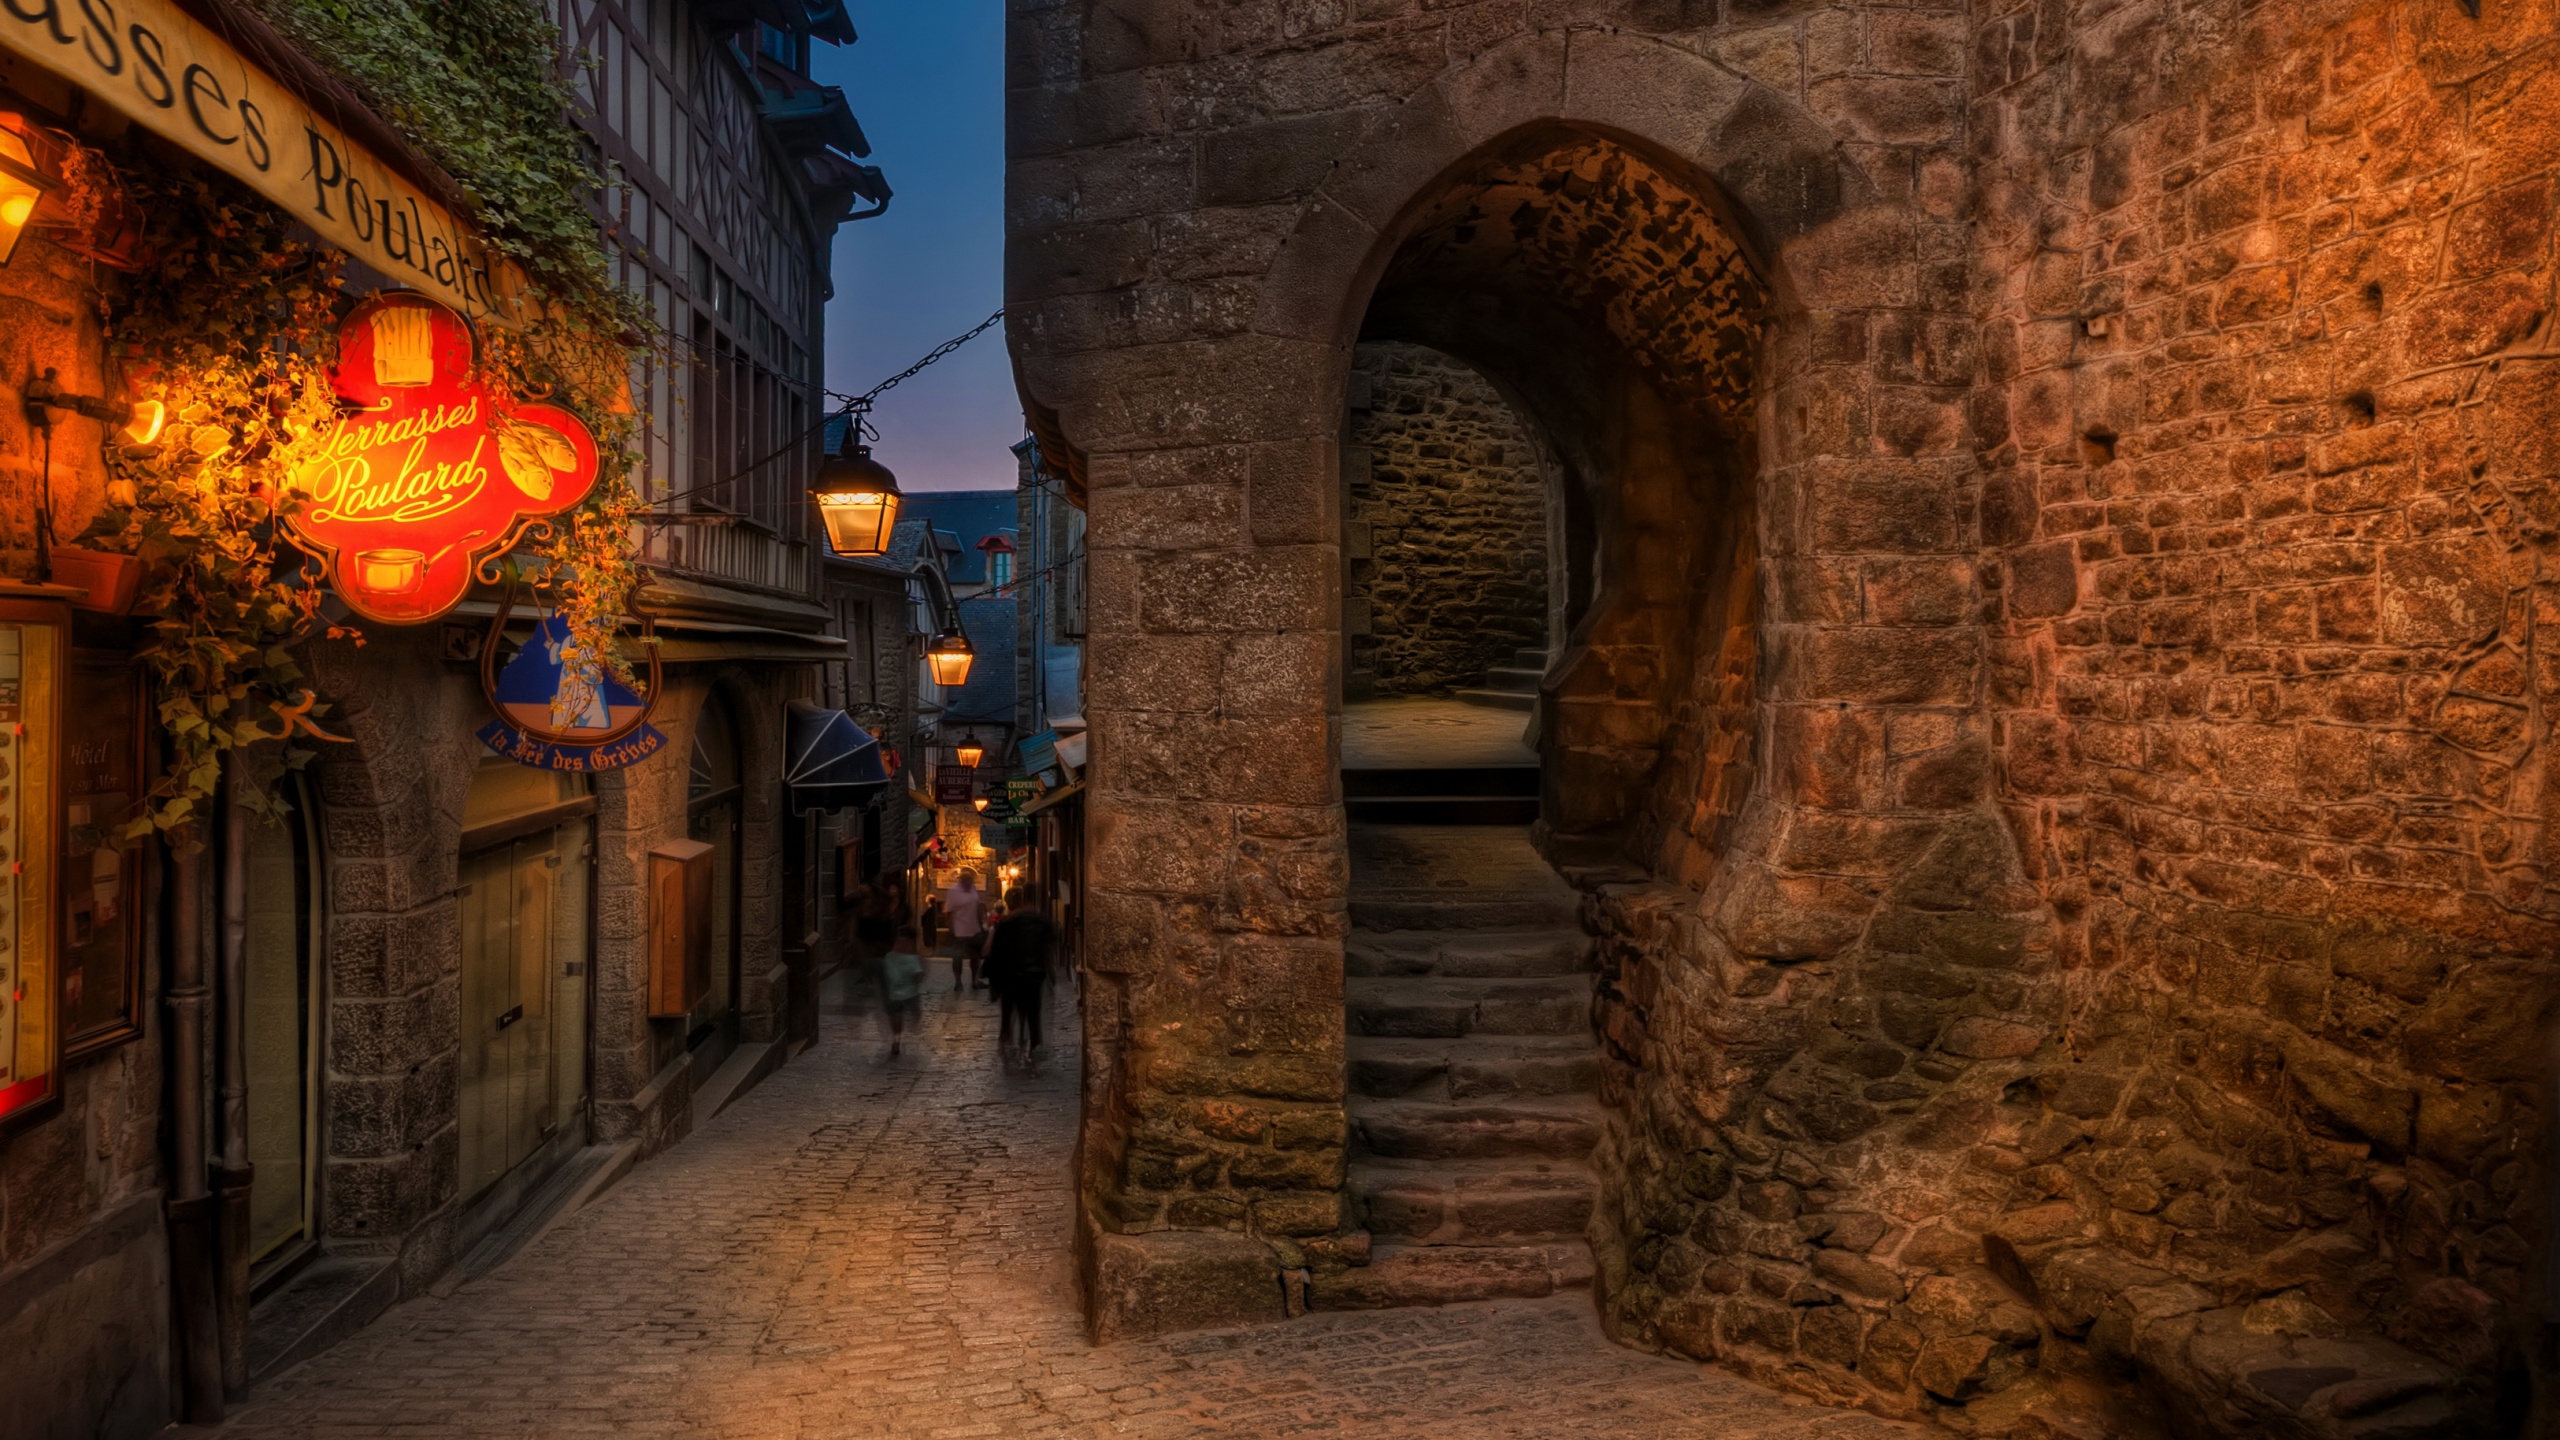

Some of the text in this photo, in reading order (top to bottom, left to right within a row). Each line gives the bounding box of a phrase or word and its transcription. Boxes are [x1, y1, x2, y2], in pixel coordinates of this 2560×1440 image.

[304, 126, 510, 320] Poulard
[306, 396, 477, 464] Terrasses
[311, 435, 487, 523] Poulard
[552, 748, 583, 771] des
[590, 733, 658, 771] Grèves
[937, 776, 972, 785] AUBERGE
